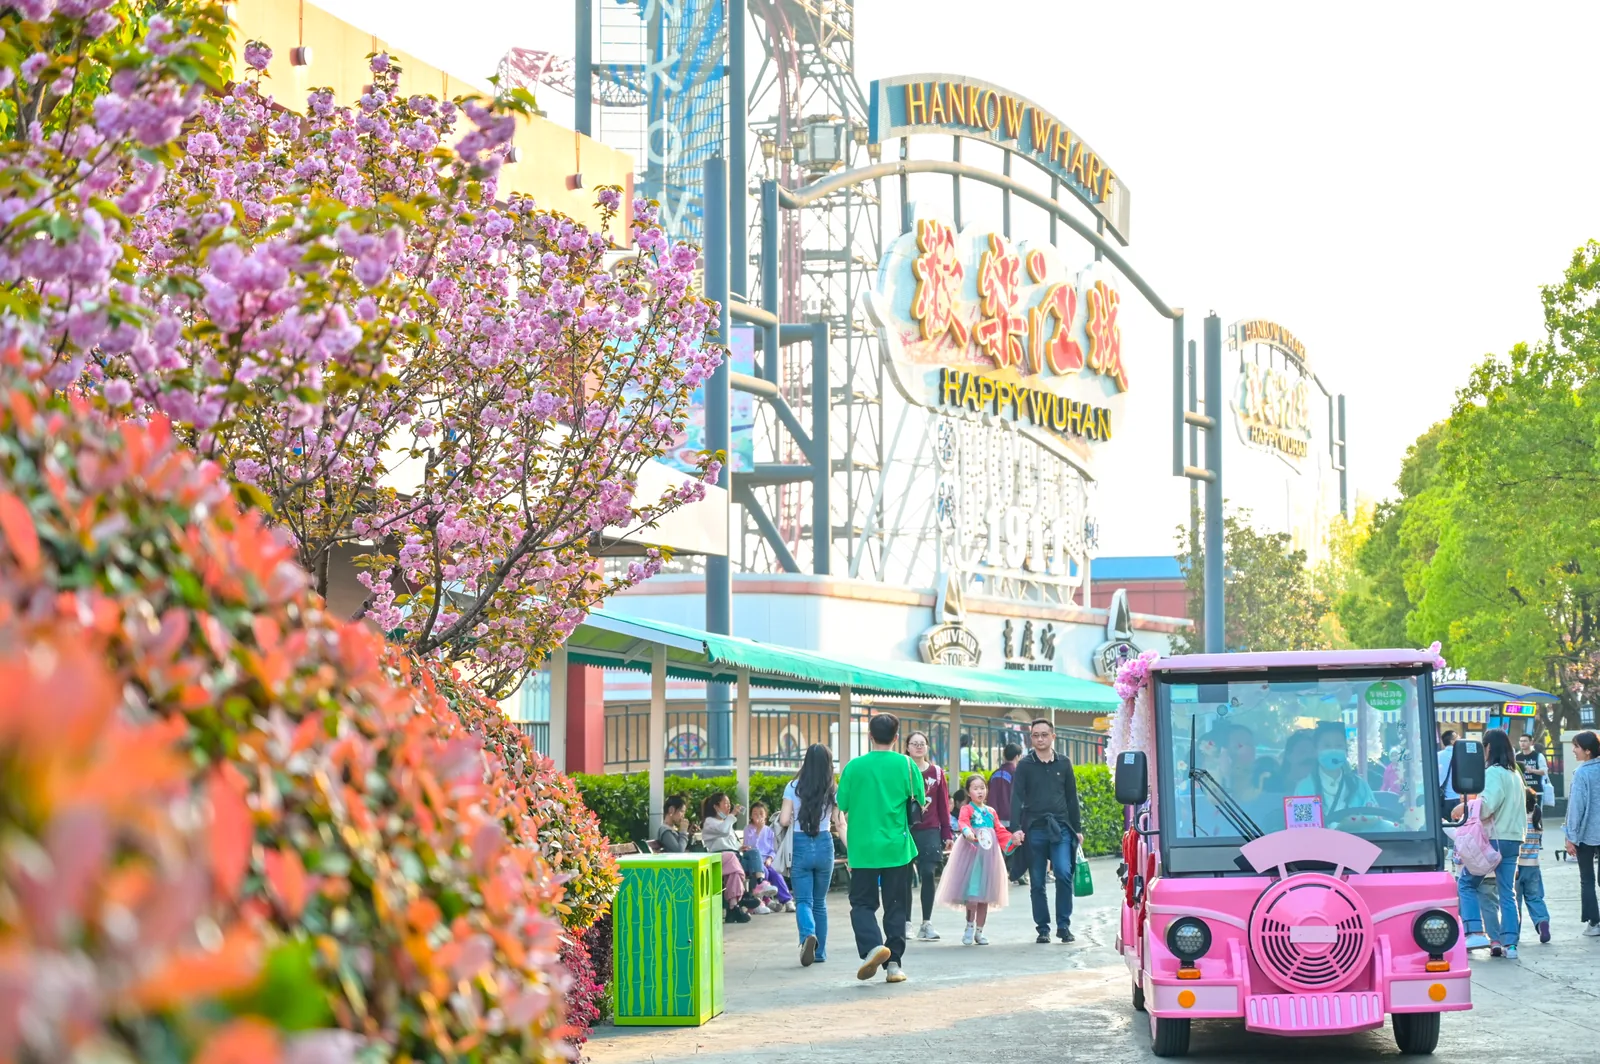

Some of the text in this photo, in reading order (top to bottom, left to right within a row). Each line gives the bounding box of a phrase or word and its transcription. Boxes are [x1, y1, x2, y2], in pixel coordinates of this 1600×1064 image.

[904, 81, 1116, 203] HANKOW WHARF
[1245, 320, 1279, 342] HANKOW
[940, 367, 1112, 442] HAPPY WUHAN
[985, 505, 1066, 576] 1911
[933, 629, 977, 653] SOUVENIR
[943, 653, 969, 667] STORE
